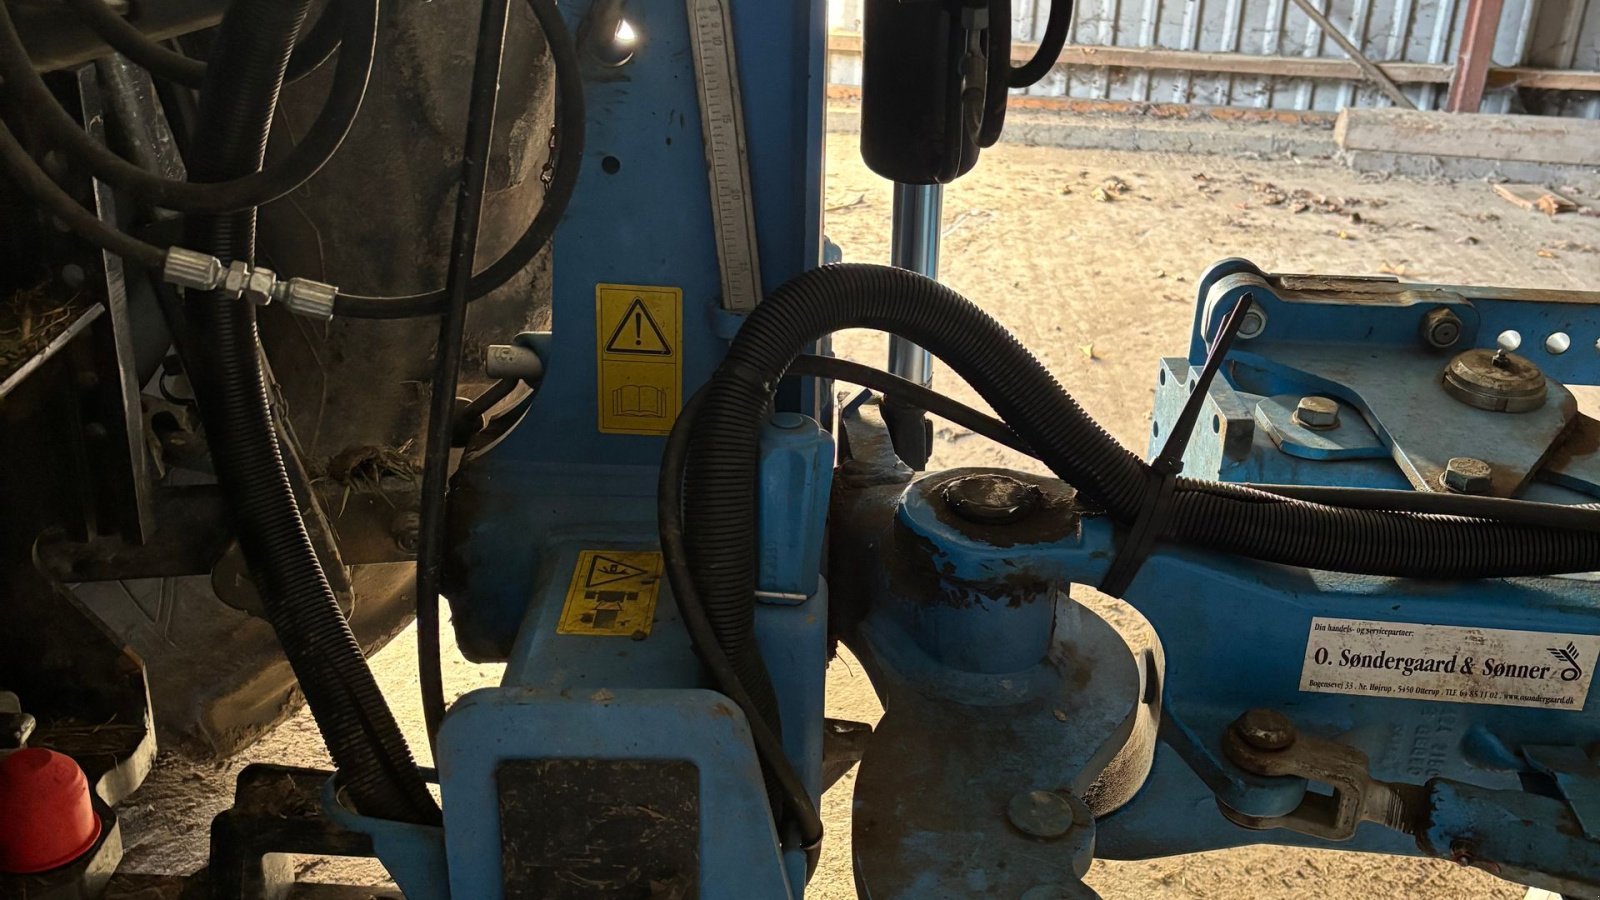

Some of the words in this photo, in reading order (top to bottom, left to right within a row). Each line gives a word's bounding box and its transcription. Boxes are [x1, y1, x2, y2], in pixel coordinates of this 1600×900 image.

[712, 35, 723, 46] 10
[721, 114, 732, 125] 15
[1314, 623, 1326, 631] Din
[1327, 623, 1355, 633] handels-
[1356, 627, 1366, 635] og
[1314, 647, 1332, 666] O.
[1338, 648, 1458, 677] Søndergaard
[1460, 656, 1475, 676] &
[1482, 657, 1550, 680] Sønner
[1309, 680, 1344, 690] Bogensevej
[1369, 683, 1392, 693] Højrup
[1397, 685, 1414, 694] 5450
[1415, 686, 1440, 696] Otterup
[1470, 690, 1479, 698] 85
[1479, 691, 1489, 699] 11
